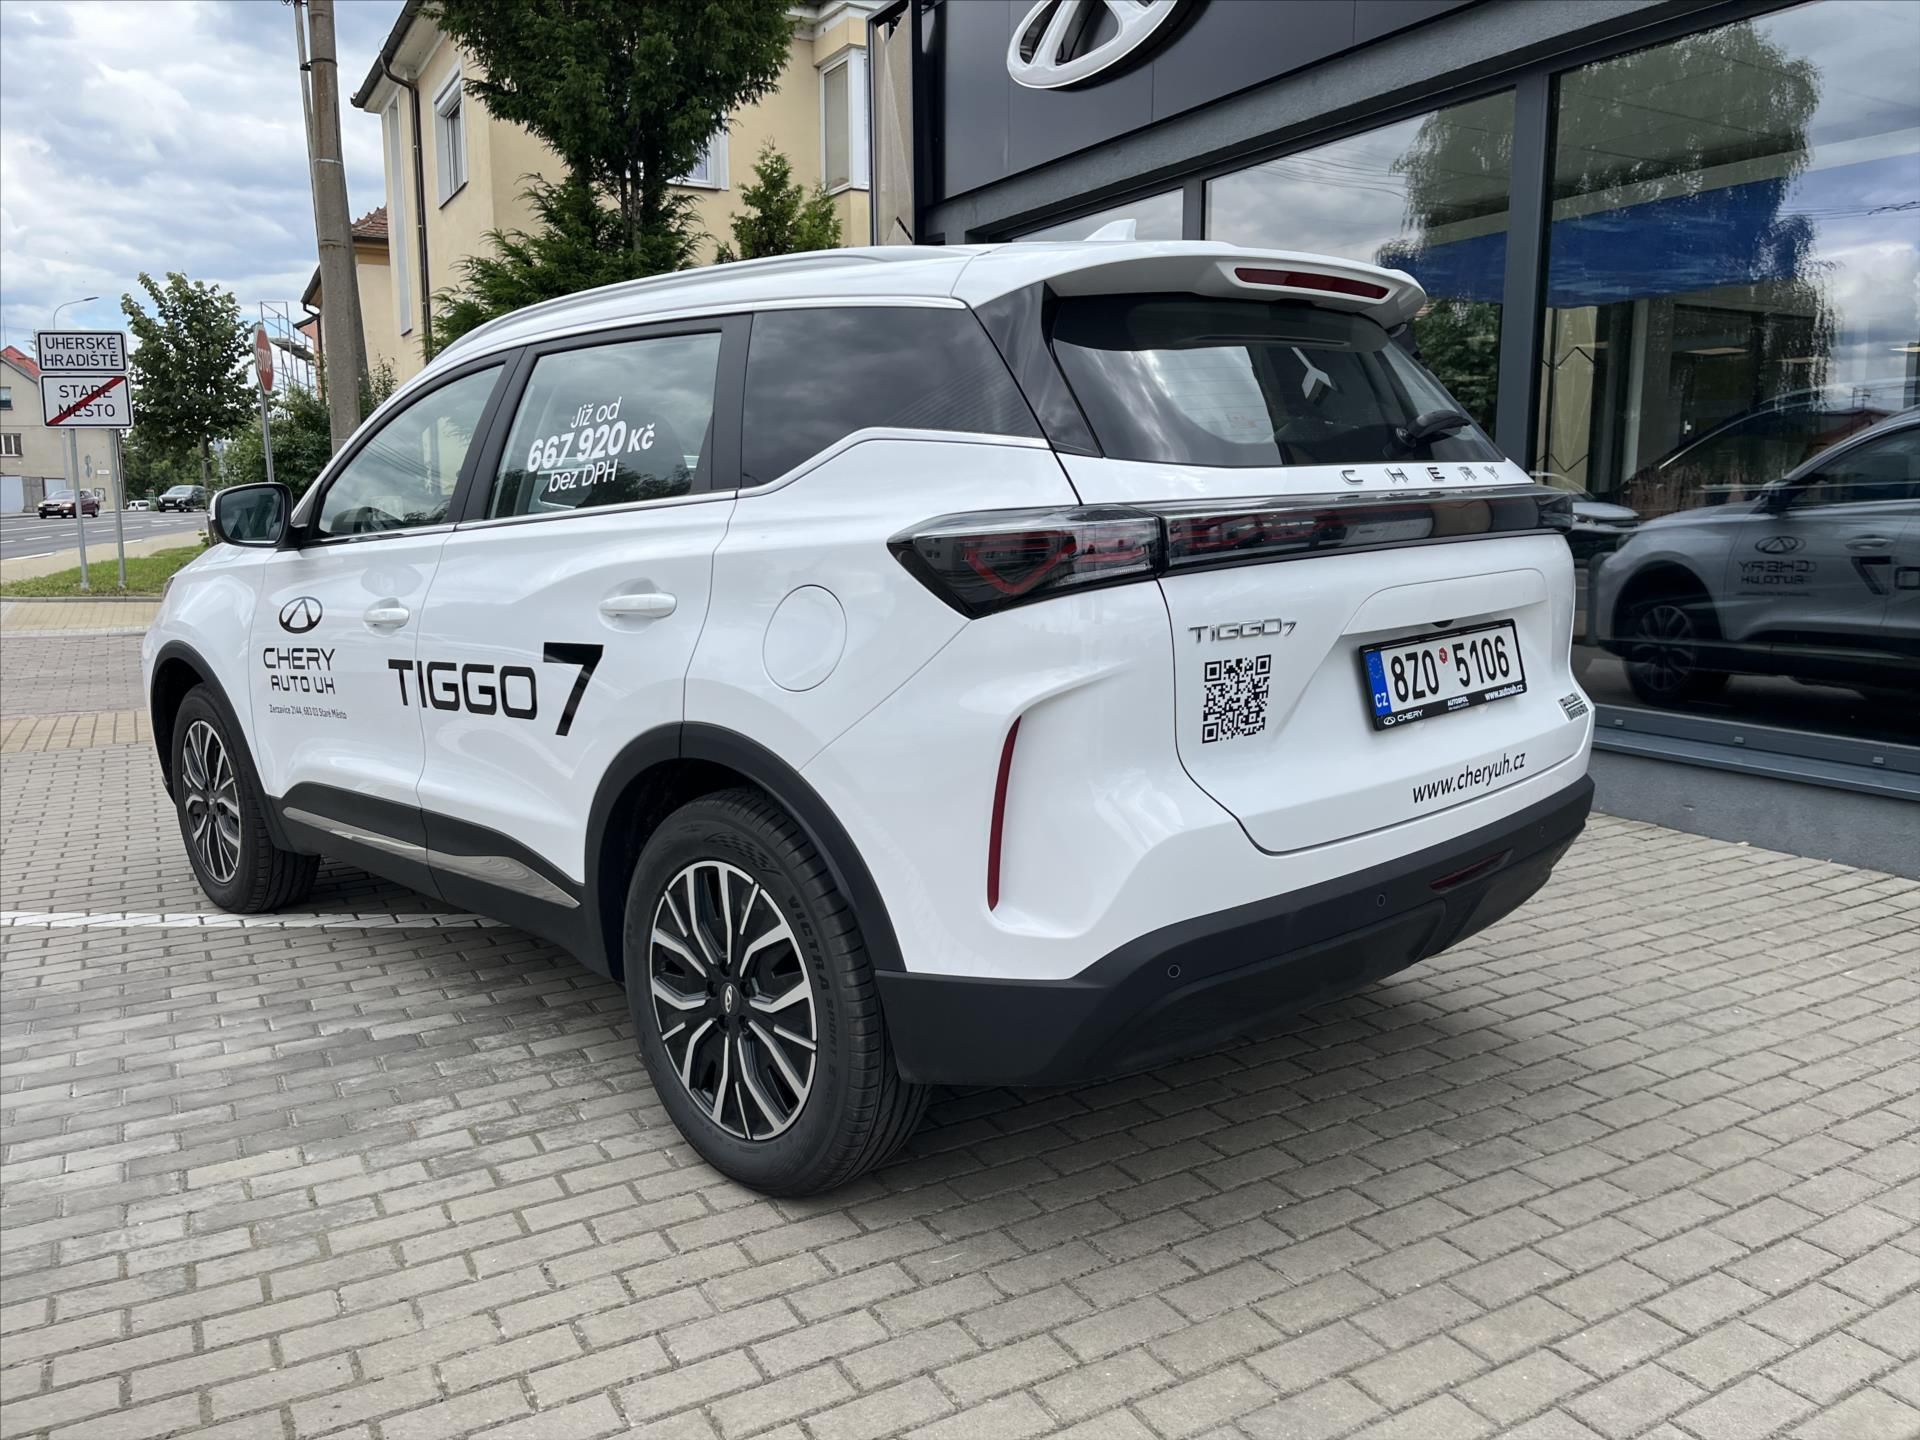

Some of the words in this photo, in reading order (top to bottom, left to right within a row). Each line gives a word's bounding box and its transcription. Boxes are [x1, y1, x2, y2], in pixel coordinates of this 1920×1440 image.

[45, 336, 117, 350] UHERSKÉ
[44, 350, 120, 366] HRADIŠTĚ
[570, 403, 594, 428] Již
[595, 396, 623, 422] od
[527, 432, 575, 473] 667
[576, 420, 627, 462] 920
[627, 423, 656, 453] Kč
[548, 471, 577, 493] bez
[581, 459, 619, 487] DPH
[1340, 465, 1500, 485] CHERY
[263, 648, 336, 671] CHERY
[1391, 650, 1440, 702] 8Z0
[1452, 635, 1510, 687] 5106
[270, 675, 311, 693] AUTO
[313, 676, 336, 695] UH
[388, 659, 538, 720] TIGGO
[543, 642, 604, 736] 7
[1374, 692, 1389, 708] CZ
[1397, 709, 1424, 723] CHERY
[1412, 753, 1526, 804] www.cheryuh.cz
